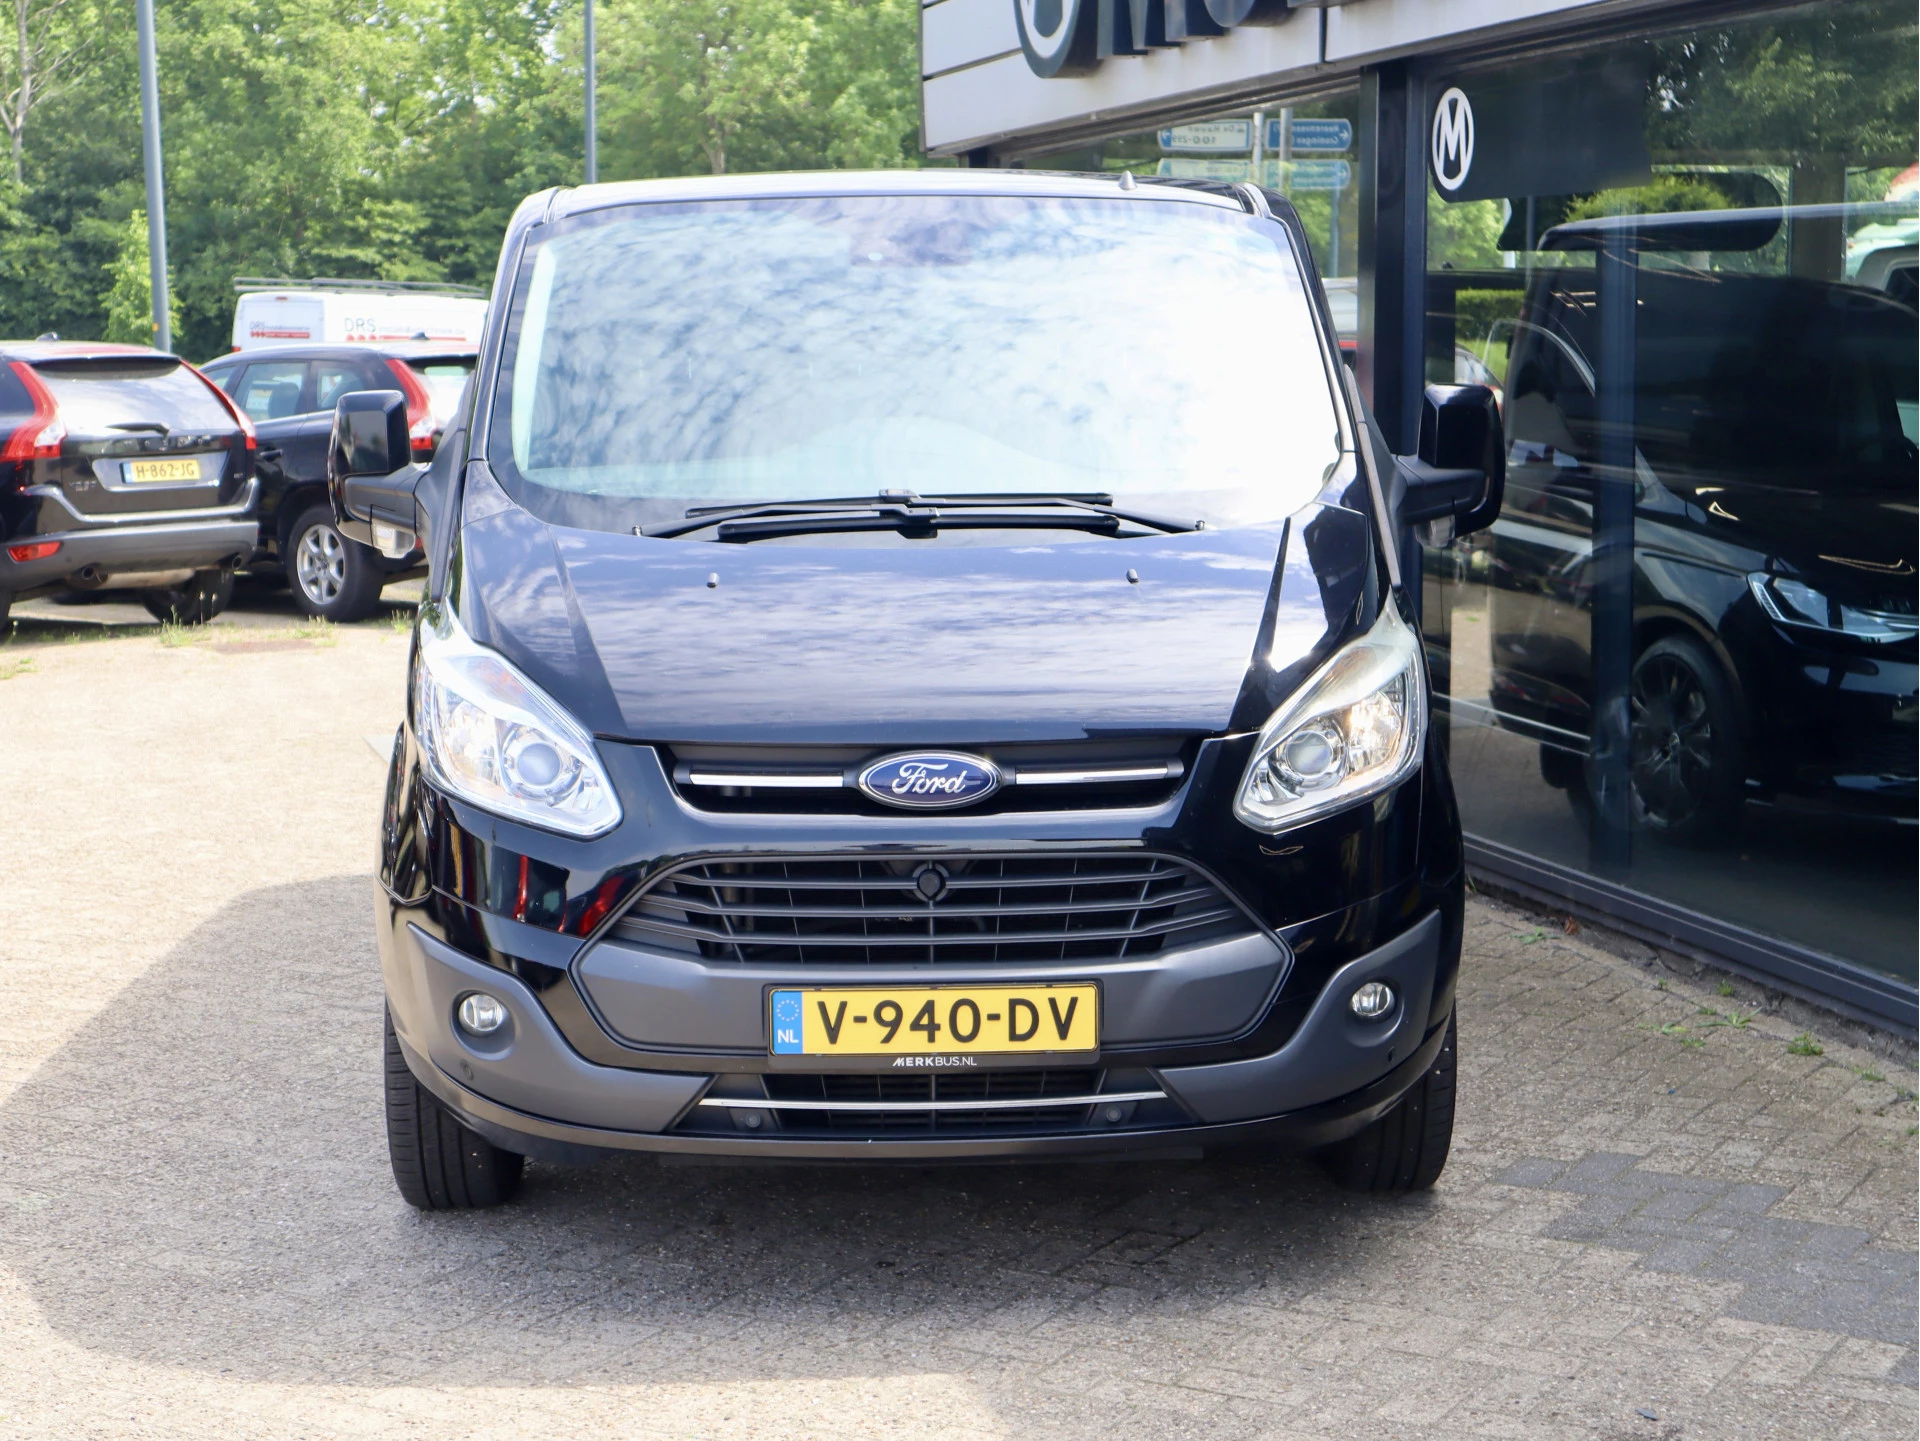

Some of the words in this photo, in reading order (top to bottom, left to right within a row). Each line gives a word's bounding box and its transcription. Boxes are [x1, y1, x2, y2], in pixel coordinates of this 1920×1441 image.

[345, 317, 376, 332] DRS
[136, 463, 195, 479] H-862-JG
[891, 762, 968, 795] Ford
[817, 996, 1079, 1045] V-940-DV
[777, 1029, 799, 1044] NL
[892, 1056, 978, 1067] MERKBUS.NL
